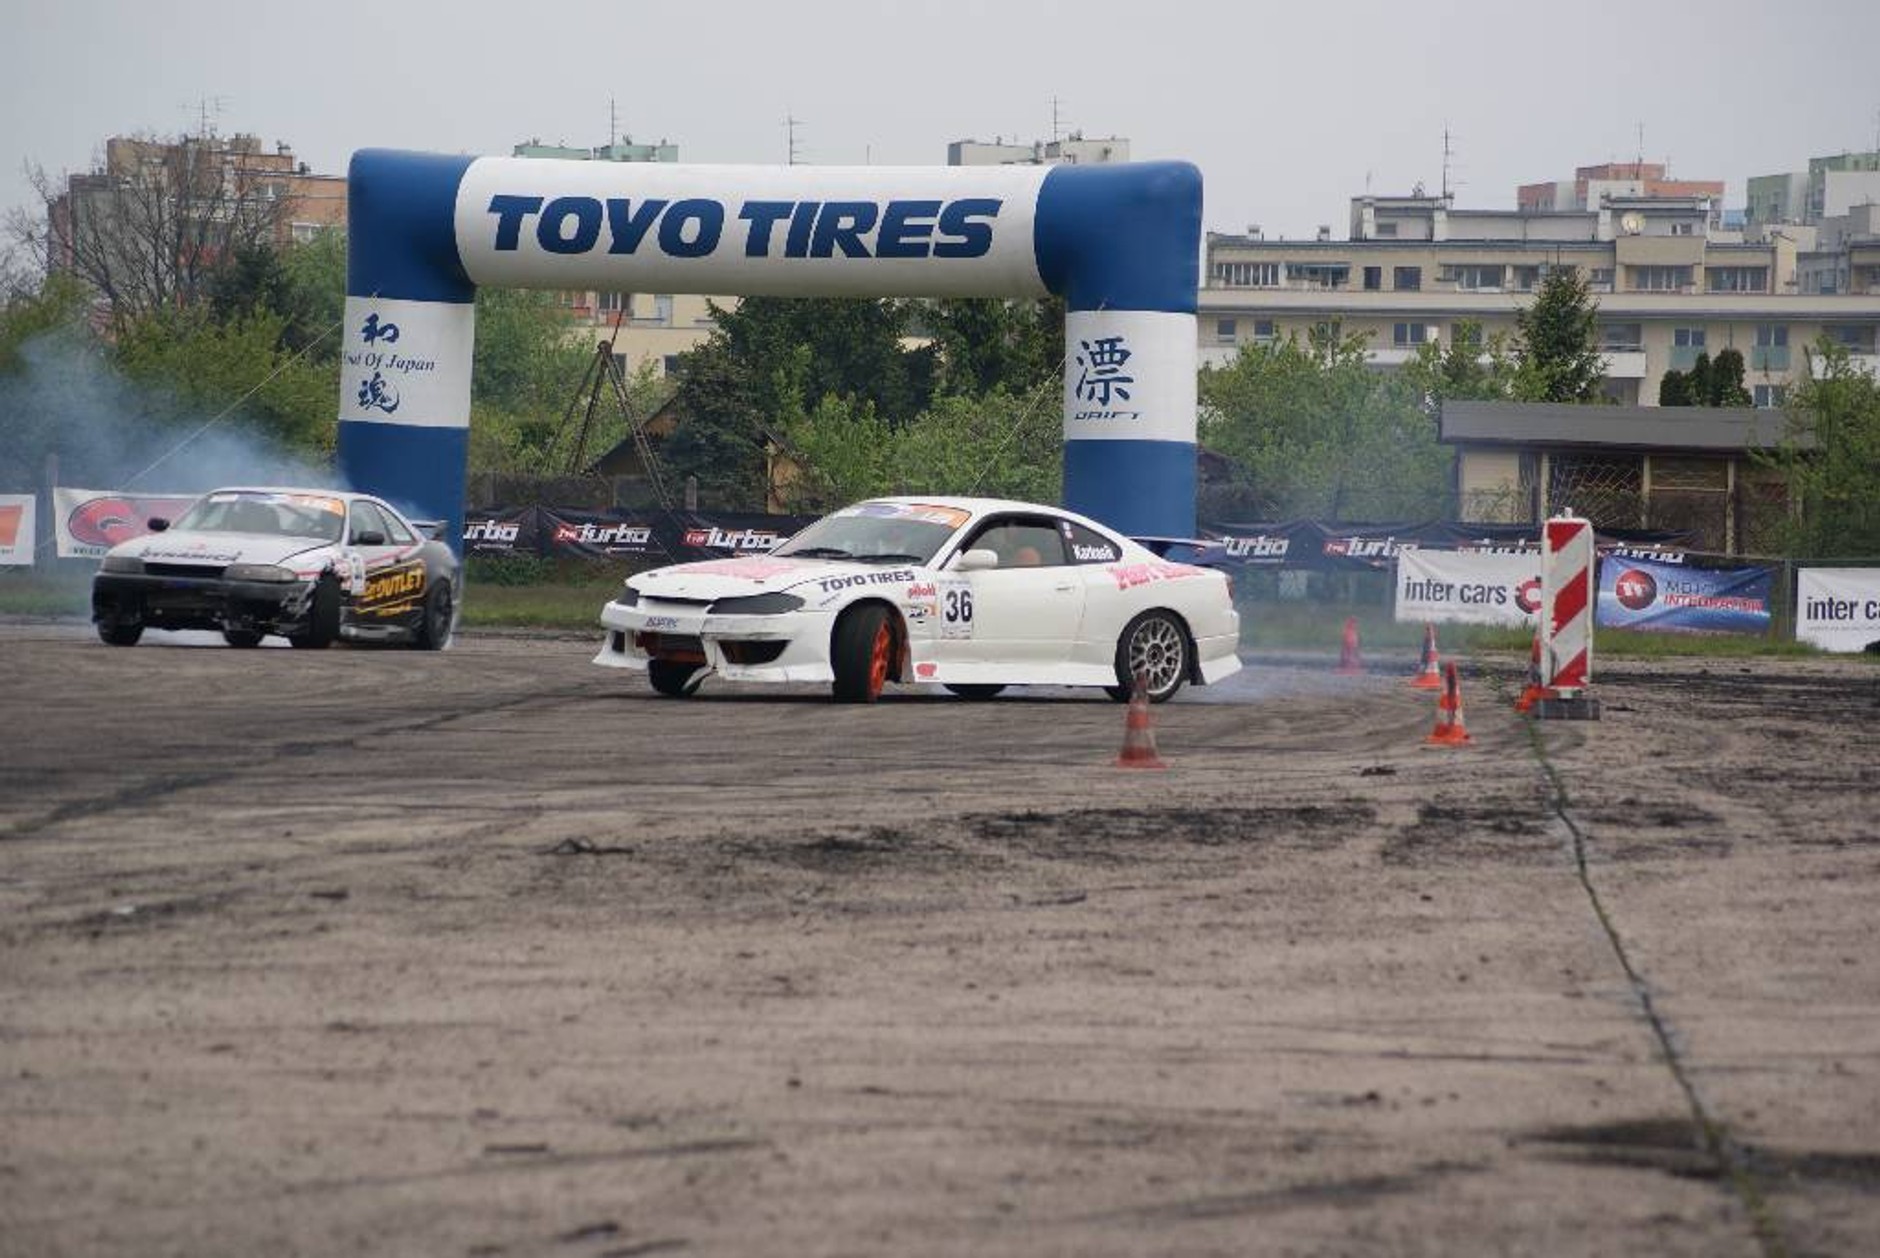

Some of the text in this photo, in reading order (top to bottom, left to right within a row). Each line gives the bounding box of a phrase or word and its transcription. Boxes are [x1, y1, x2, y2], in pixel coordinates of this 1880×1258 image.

[487, 194, 1004, 258] TOYO TIRES
[386, 354, 435, 374] Japan
[1075, 336, 1134, 407] 漂
[820, 570, 916, 592] TOYO TIRES
[1404, 576, 1507, 605] inter cars
[945, 589, 973, 623] 36
[1806, 596, 1880, 620] inter c
